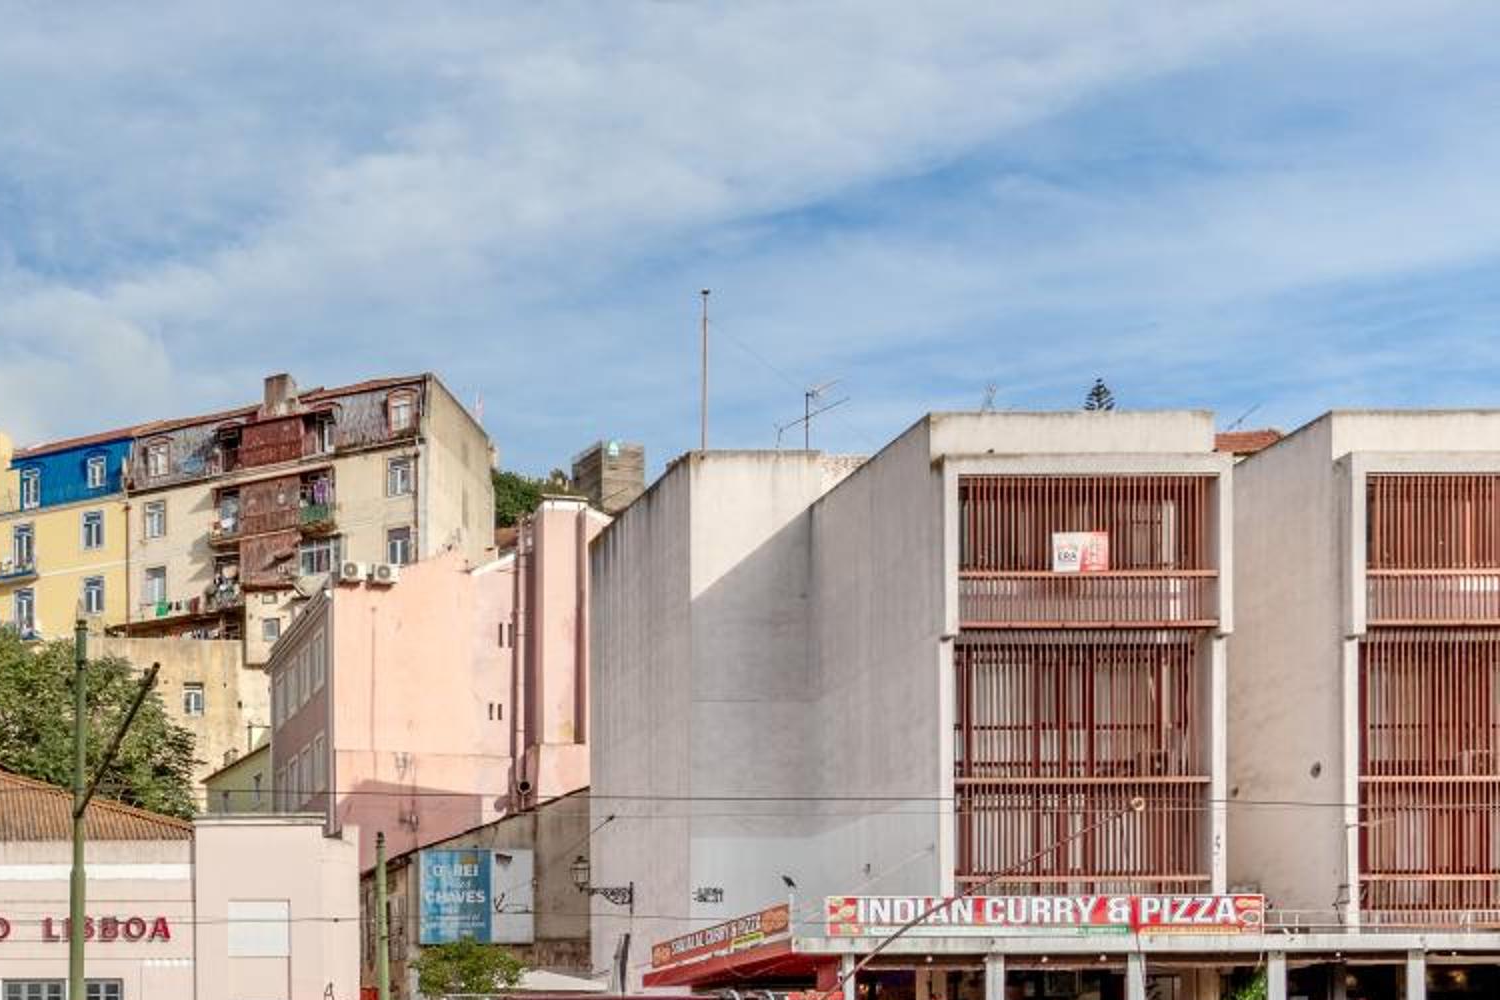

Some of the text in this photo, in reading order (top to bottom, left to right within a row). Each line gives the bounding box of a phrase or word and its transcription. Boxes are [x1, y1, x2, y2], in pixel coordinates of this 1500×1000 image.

[858, 897, 1237, 924] INDIAN CURRY & PIZZA
